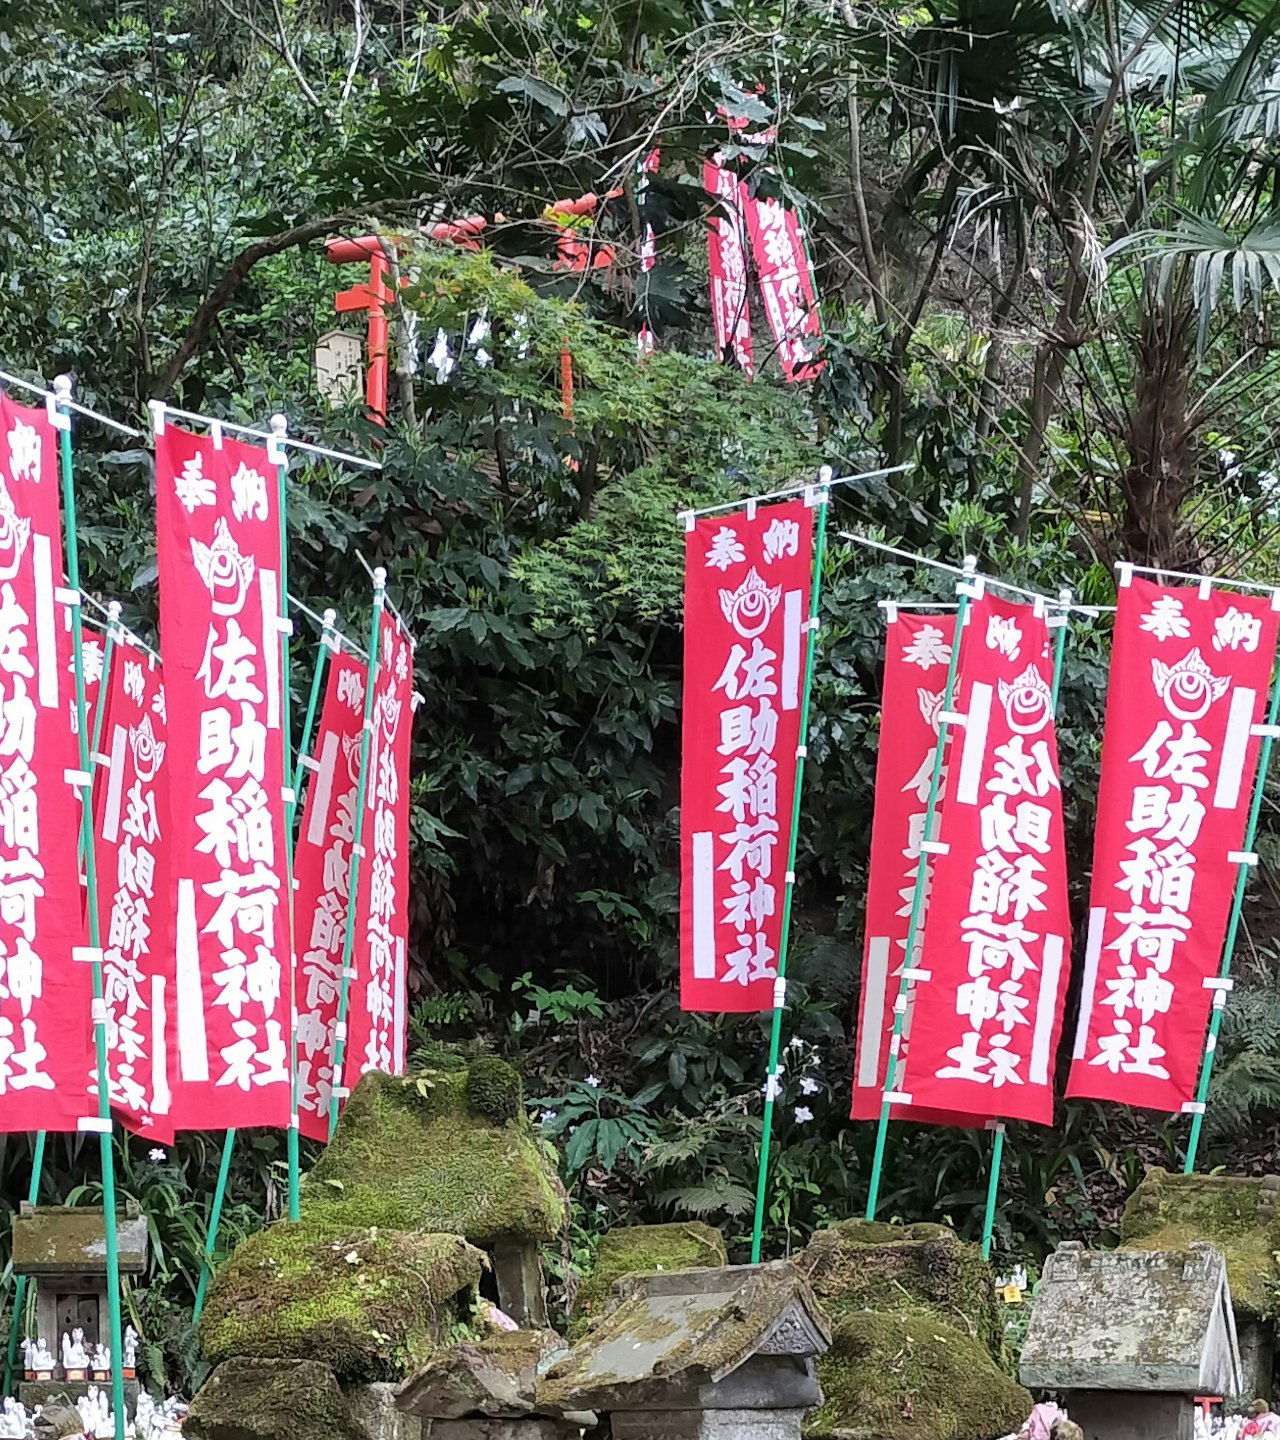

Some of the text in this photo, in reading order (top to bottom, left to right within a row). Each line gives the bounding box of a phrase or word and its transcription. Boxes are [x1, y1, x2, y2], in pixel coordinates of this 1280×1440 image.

[174, 451, 269, 522] 奉納
[704, 519, 799, 571] 奉納
[1138, 596, 1261, 653] 奉納
[194, 617, 289, 1091] 佐助稲荷神社
[712, 637, 778, 987] 佐助稲荷神社
[1090, 721, 1213, 1080] 佐助稲荷神社
